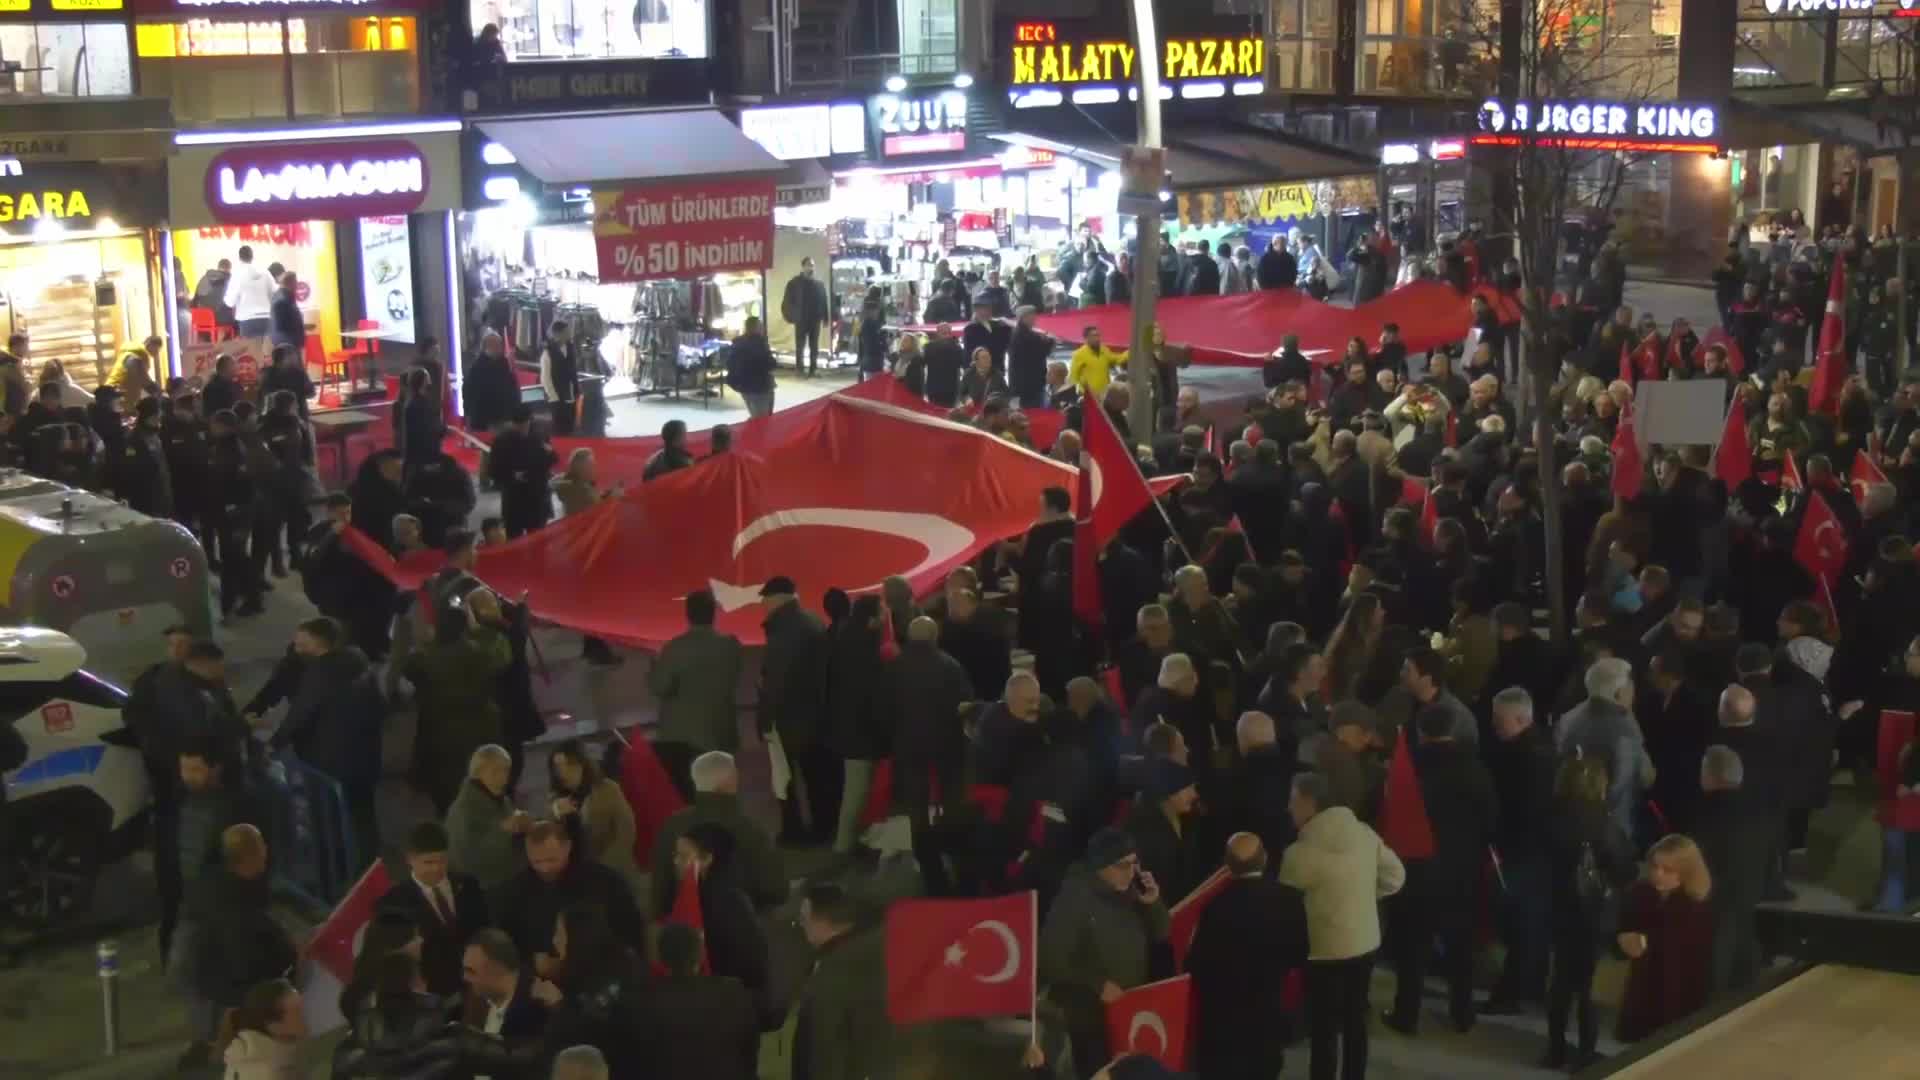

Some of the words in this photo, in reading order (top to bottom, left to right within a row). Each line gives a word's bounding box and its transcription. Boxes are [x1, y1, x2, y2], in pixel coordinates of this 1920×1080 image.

[1013, 43, 1135, 83] MALATY
[1165, 39, 1264, 79] PAZARI
[1637, 106, 1714, 137] KING
[626, 198, 666, 227] TÜM
[671, 192, 769, 224] ÜRÜNLERDE
[684, 234, 765, 270] İNDİRİM
